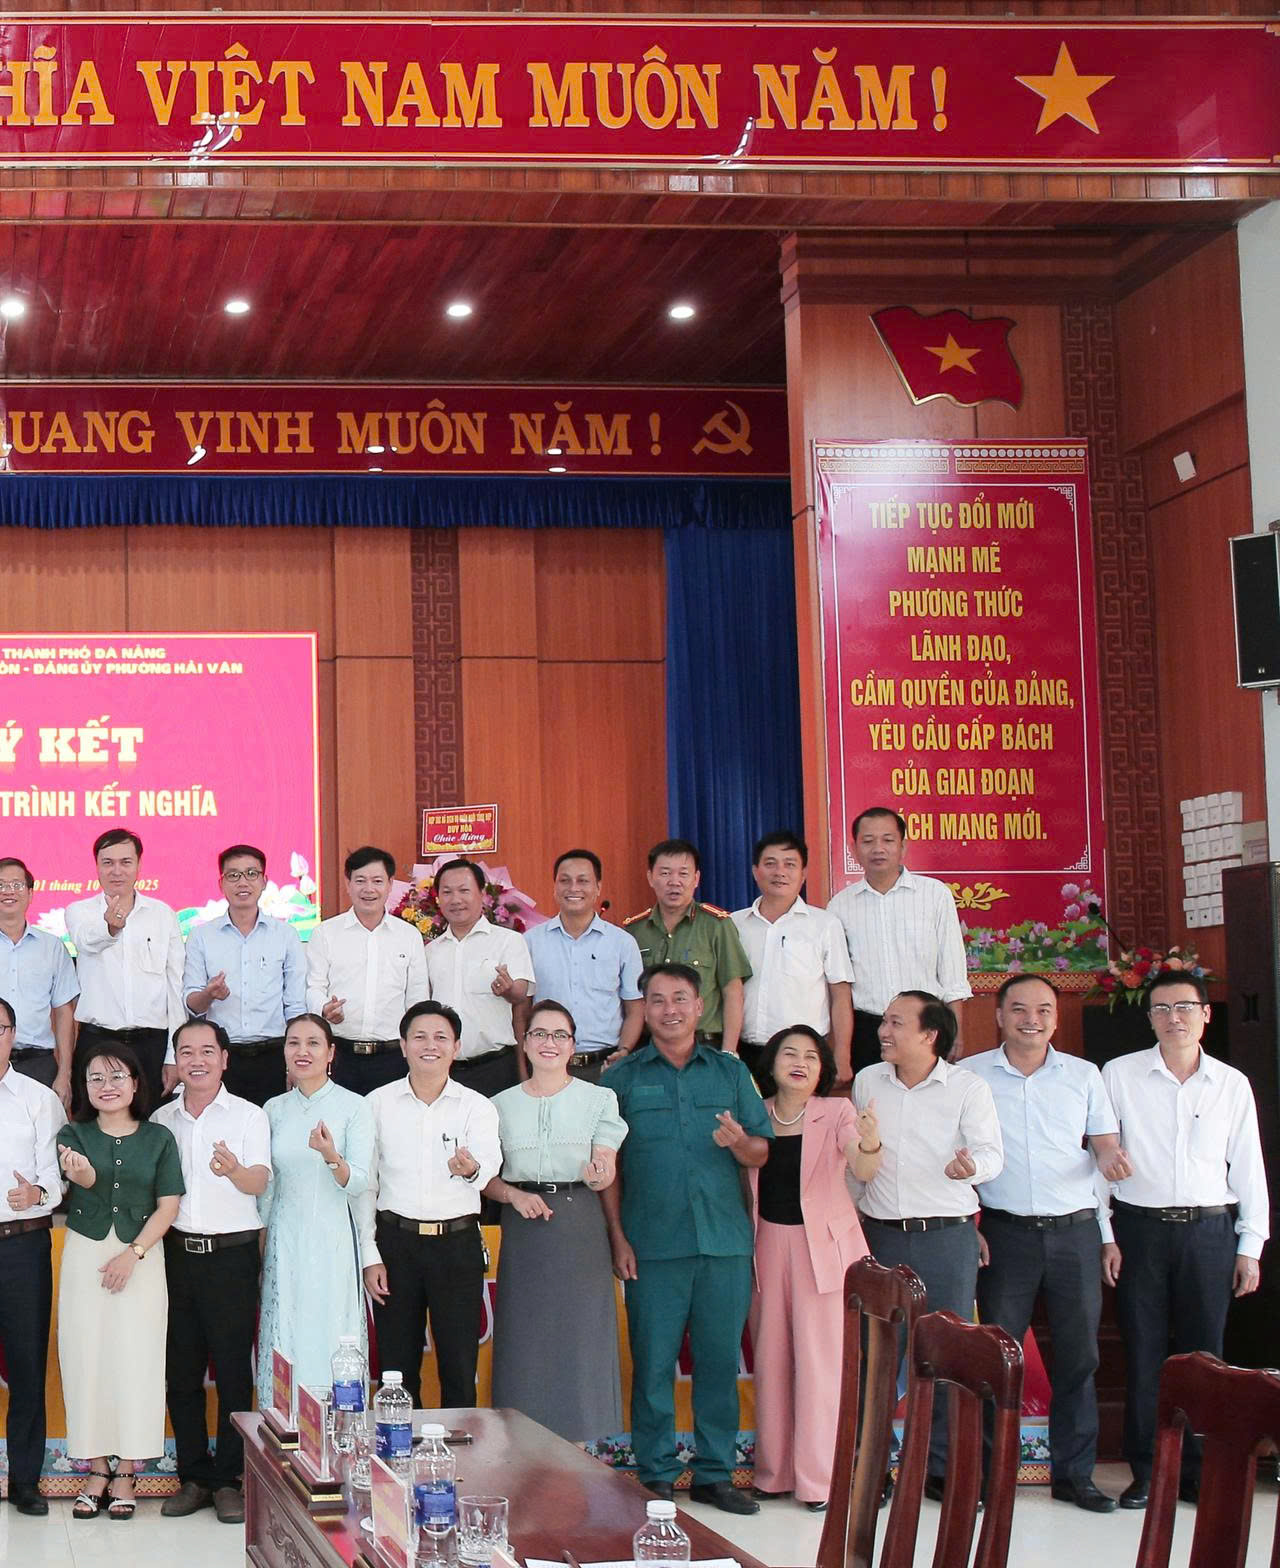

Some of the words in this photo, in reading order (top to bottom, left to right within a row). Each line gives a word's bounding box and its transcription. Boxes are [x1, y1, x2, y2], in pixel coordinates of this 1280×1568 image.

[137, 43, 314, 140] VIỆT
[341, 62, 502, 126] NAM
[528, 48, 720, 128] MUÔN
[175, 410, 315, 454] VINH
[336, 398, 488, 454] MUÔN
[869, 493, 910, 529] TIẾP
[917, 503, 953, 535] TỤC
[958, 491, 992, 529] ĐỔI
[998, 498, 1034, 529] MỚI
[907, 547, 964, 579] MẠNH
[972, 541, 1000, 573] MẼ
[889, 589, 967, 618] PHƯƠNG
[974, 587, 1023, 618] THỨC
[911, 629, 961, 661] LÃNH
[968, 636, 1012, 667] ĐẠO,
[851, 671, 894, 706] CẦM
[901, 672, 964, 710] QUYỀN
[971, 671, 1010, 706] CỦA
[1015, 671, 1074, 710] ĐẢNG,
[39, 714, 144, 763] KẾT
[869, 719, 905, 751] YÊU
[912, 715, 950, 751] CẦU
[956, 715, 995, 751] CẤP
[1001, 719, 1053, 751] BÁCH
[85, 781, 134, 817] KẾT
[139, 782, 218, 817] NGHĨA
[891, 759, 931, 796] CỦA
[937, 768, 975, 796] GIAI
[981, 768, 1035, 801] ĐOẠN
[940, 813, 998, 846] MẠNG
[1004, 807, 1047, 840] MỚI.
[49, 880, 82, 894] tháng
[86, 880, 100, 891] 10
